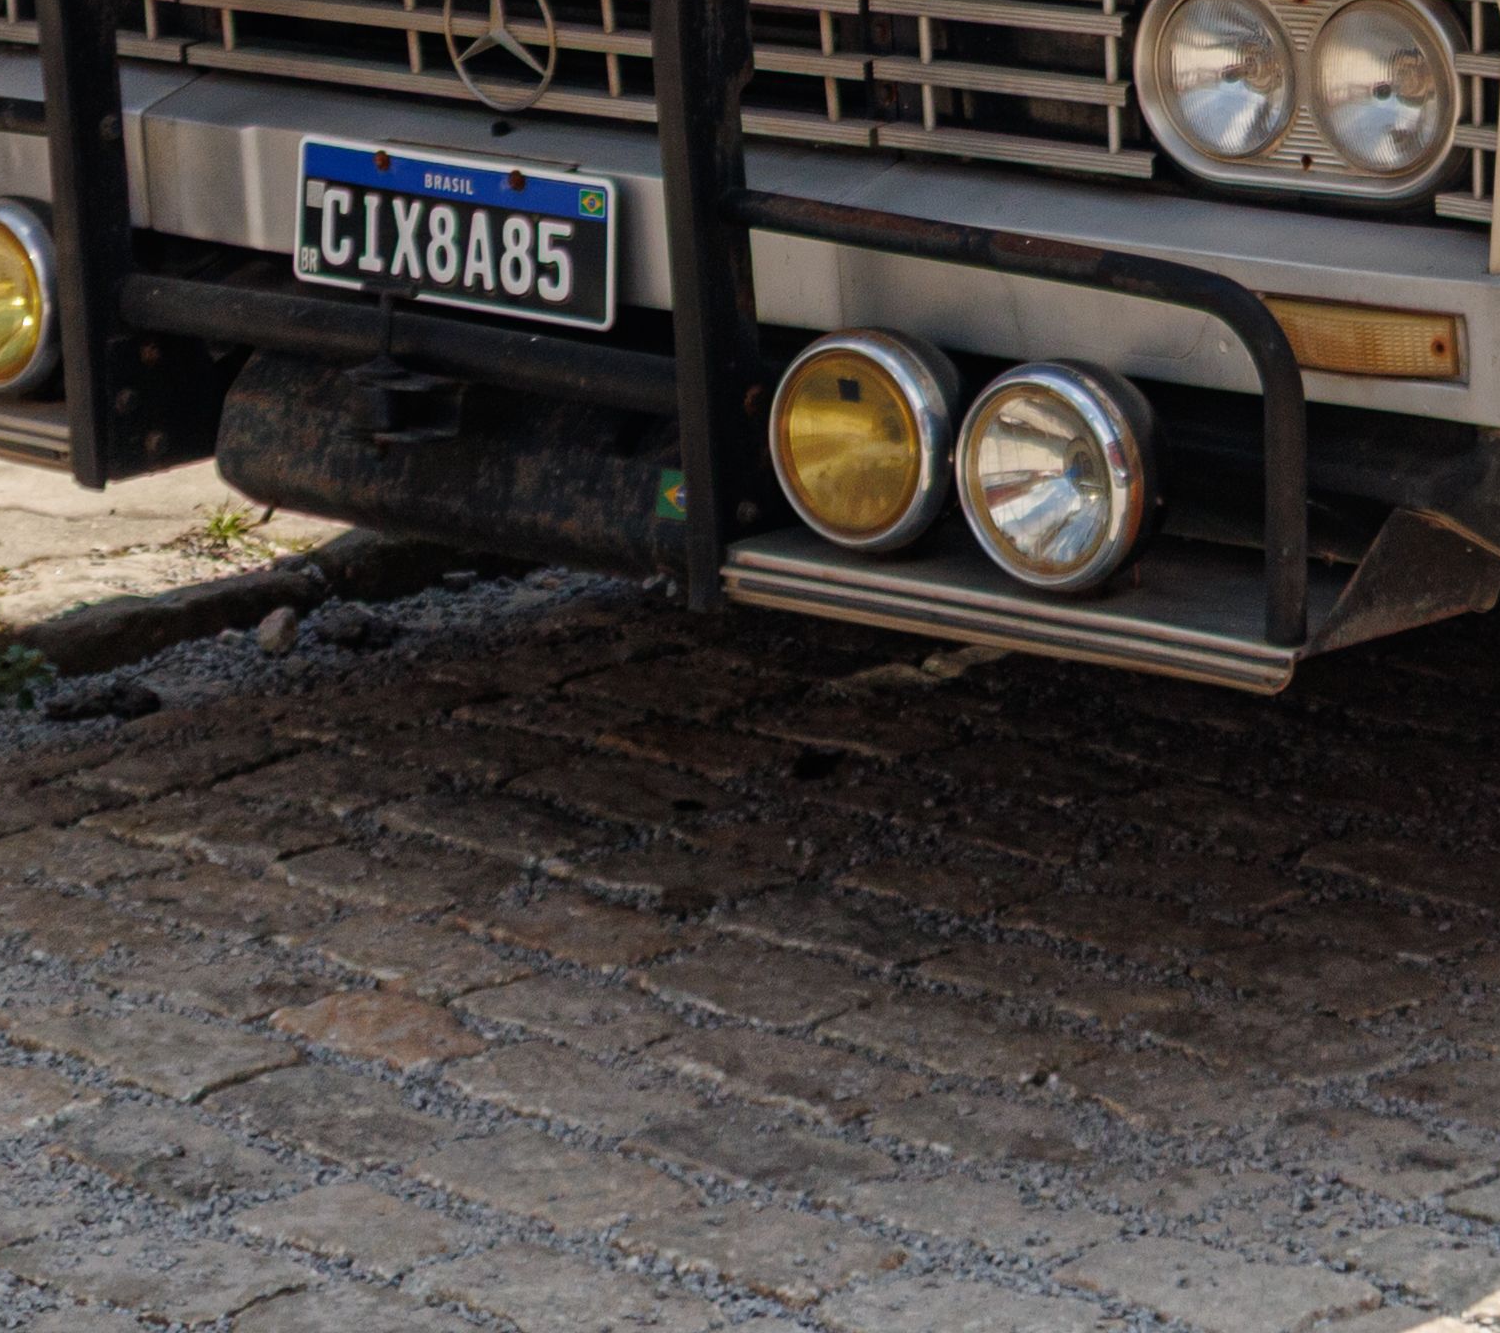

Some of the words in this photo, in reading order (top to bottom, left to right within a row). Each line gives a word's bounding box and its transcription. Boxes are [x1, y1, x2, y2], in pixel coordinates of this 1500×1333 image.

[424, 173, 475, 196] BRASIL
[321, 188, 572, 303] CIX8A85
[301, 247, 318, 273] BR
